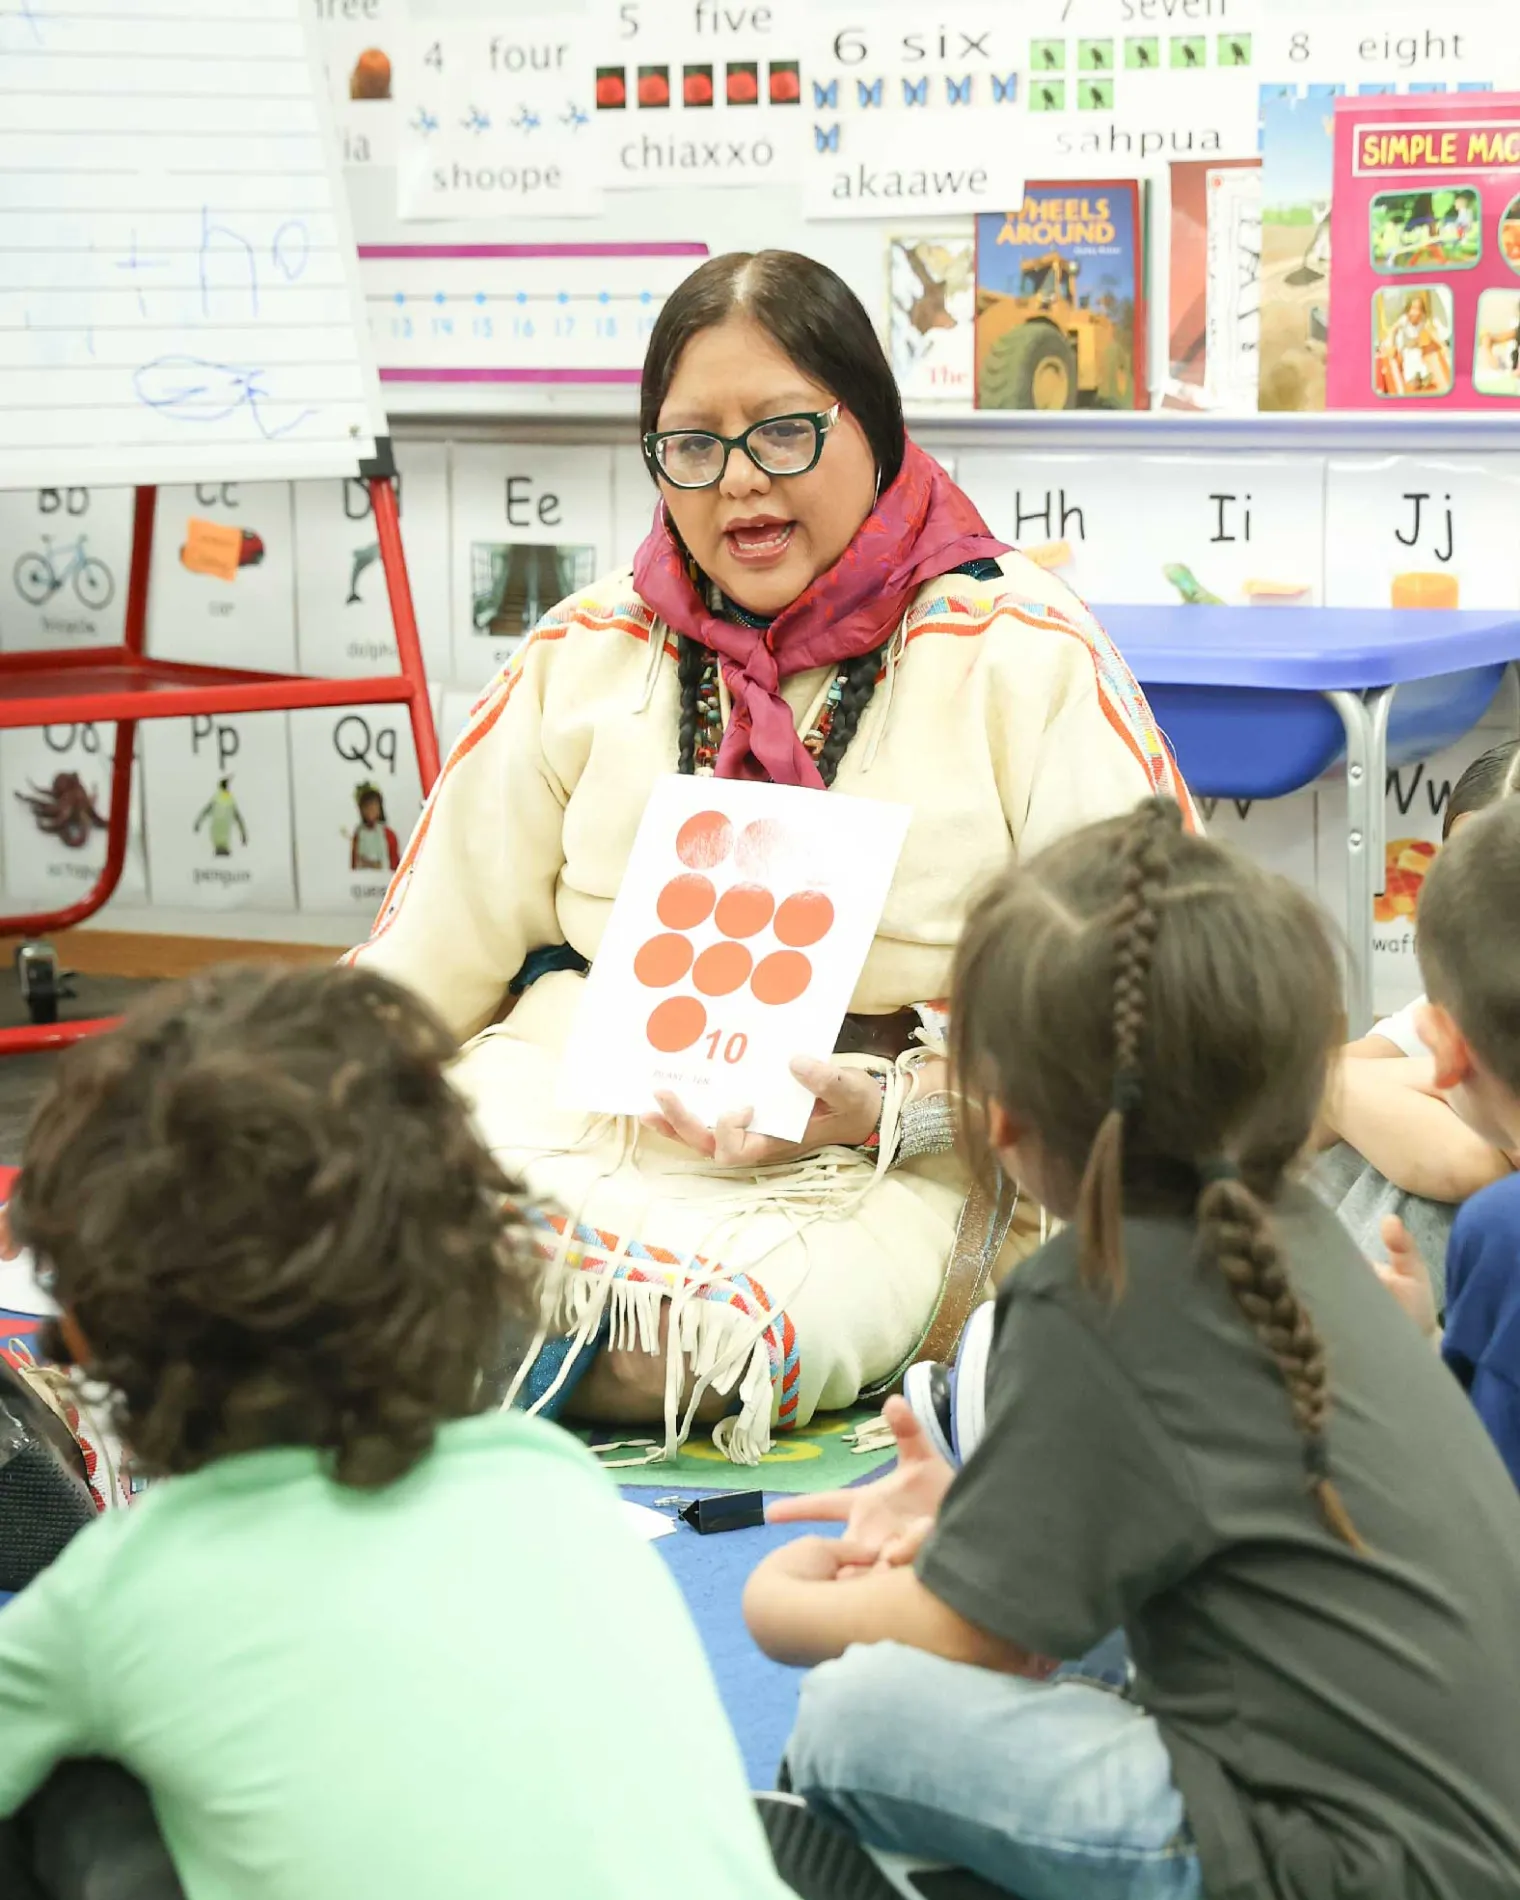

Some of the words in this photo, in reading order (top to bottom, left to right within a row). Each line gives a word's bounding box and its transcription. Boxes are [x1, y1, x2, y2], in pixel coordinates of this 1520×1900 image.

[619, 3, 639, 39] 5
[694, 0, 772, 34] five
[423, 39, 443, 73] 4
[488, 35, 569, 72] four
[833, 28, 868, 66] 6
[900, 24, 991, 62] six
[1288, 31, 1310, 62] 8
[1358, 29, 1462, 67] eight
[1057, 124, 1222, 158] sahpua
[1362, 132, 1458, 167] SIMPLE
[432, 163, 562, 194] shoope
[996, 220, 1116, 246] AROUND
[513, 316, 536, 338] 16
[555, 316, 575, 336] 17
[596, 316, 618, 337] 18
[505, 476, 562, 527] Ee
[1015, 489, 1085, 541] Hh
[1209, 494, 1253, 542] Ii
[1395, 493, 1455, 562] Jj
[191, 715, 239, 770] Pp
[333, 715, 398, 774] Qq
[705, 1029, 748, 1064] 10
